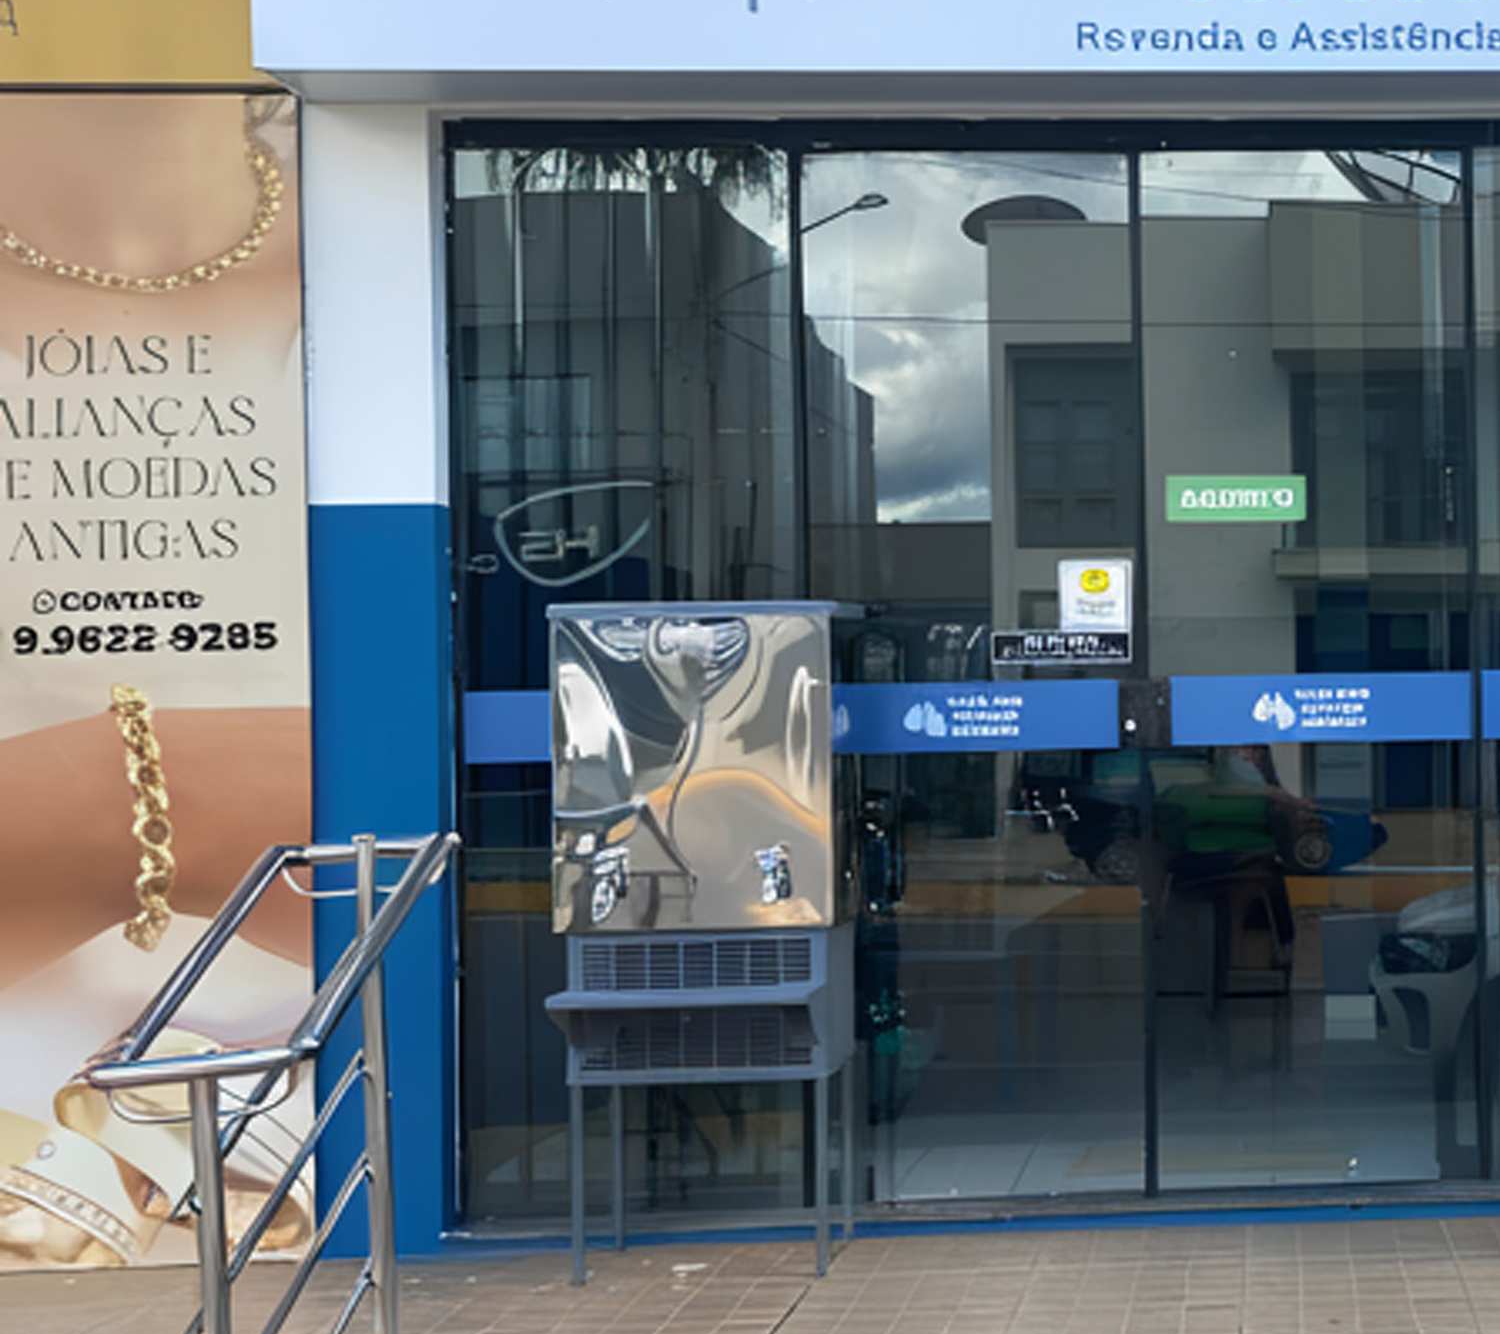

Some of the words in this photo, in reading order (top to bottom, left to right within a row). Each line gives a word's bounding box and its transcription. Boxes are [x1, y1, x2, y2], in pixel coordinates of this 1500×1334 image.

[188, 334, 212, 374] E
[52, 457, 278, 499] MOEDAS
[9, 518, 240, 561] ANTIGAS
